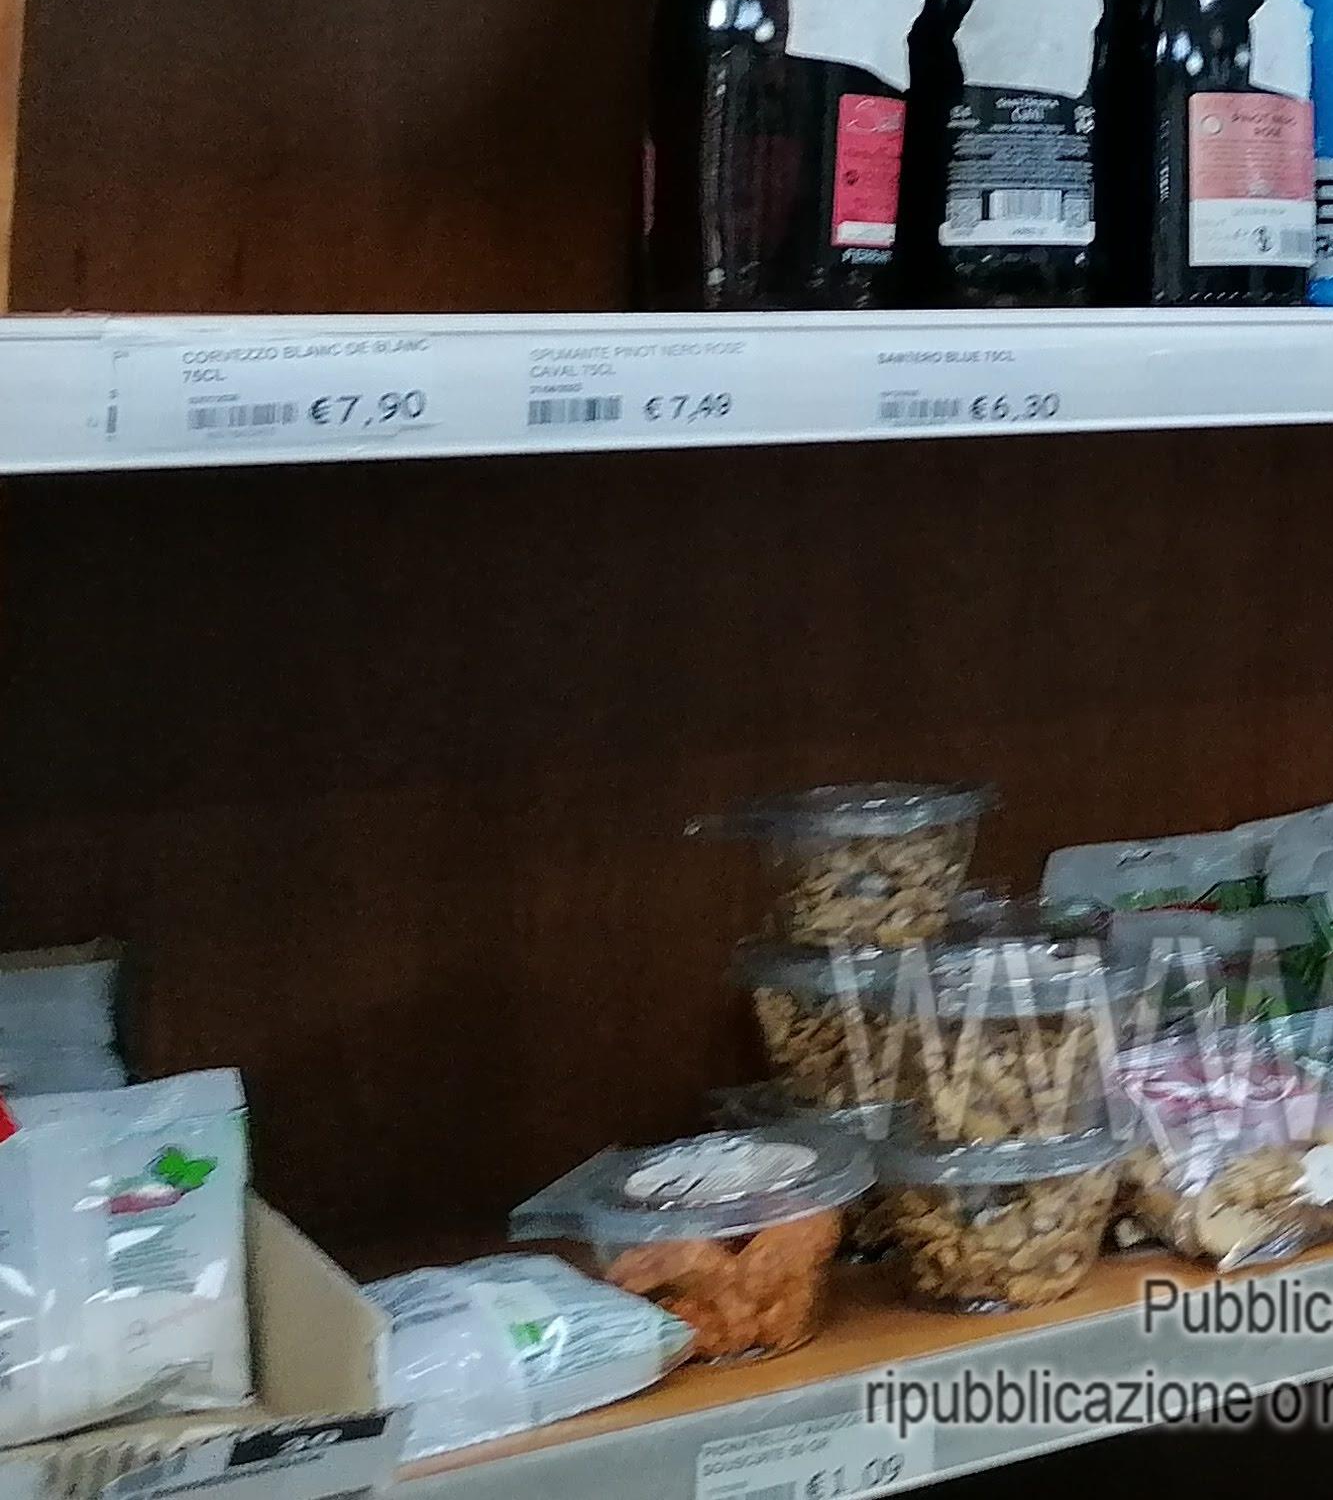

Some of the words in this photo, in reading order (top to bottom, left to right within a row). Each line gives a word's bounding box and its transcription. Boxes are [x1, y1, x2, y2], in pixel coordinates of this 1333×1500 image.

[181, 347, 278, 366] CORVEZZO
[283, 342, 341, 360] BLANC
[946, 350, 981, 364] BLUE
[181, 367, 228, 383] 75CL
[308, 388, 427, 428] €7,90
[968, 391, 1061, 423] €6,30
